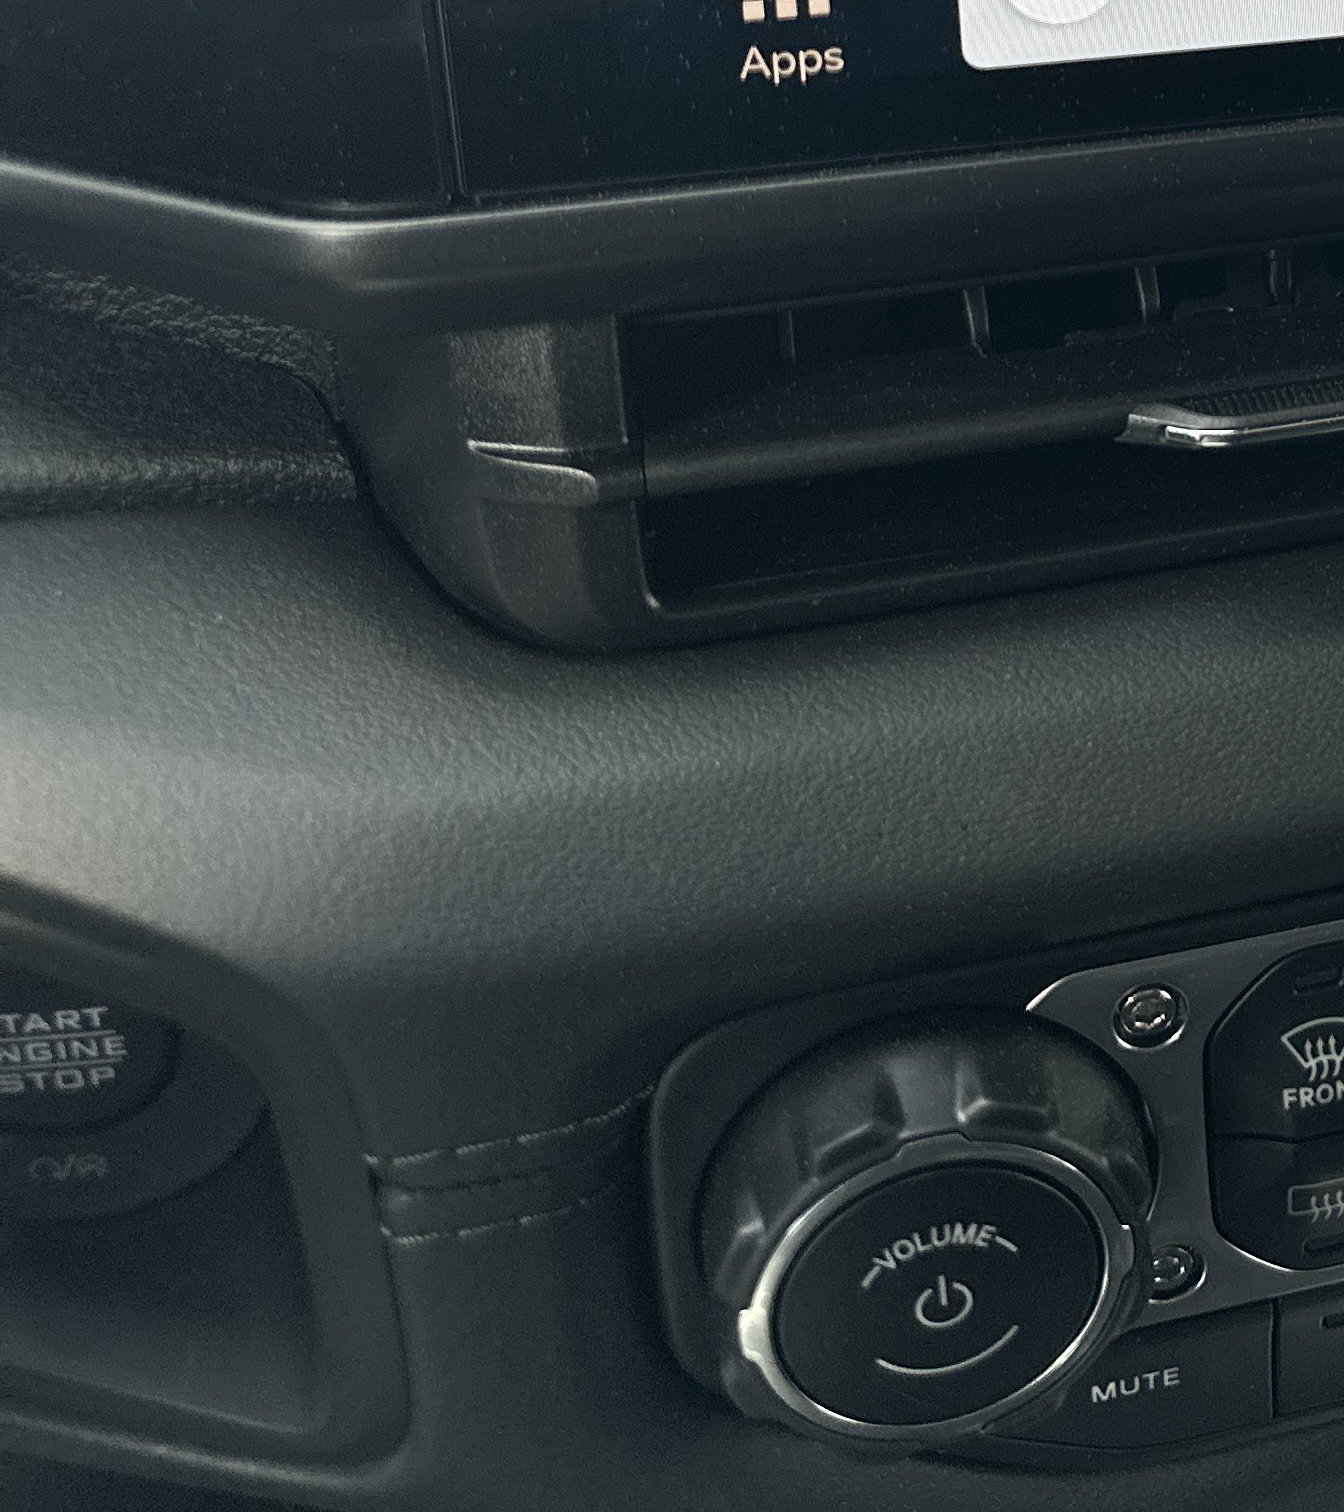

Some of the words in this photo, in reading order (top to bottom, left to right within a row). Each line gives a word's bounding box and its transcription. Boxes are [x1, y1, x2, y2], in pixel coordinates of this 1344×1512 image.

[740, 45, 845, 84] Apps
[0, 1066, 116, 1094] STOP
[871, 1221, 999, 1274] VOLUME
[1090, 1366, 1182, 1405] MUTE
